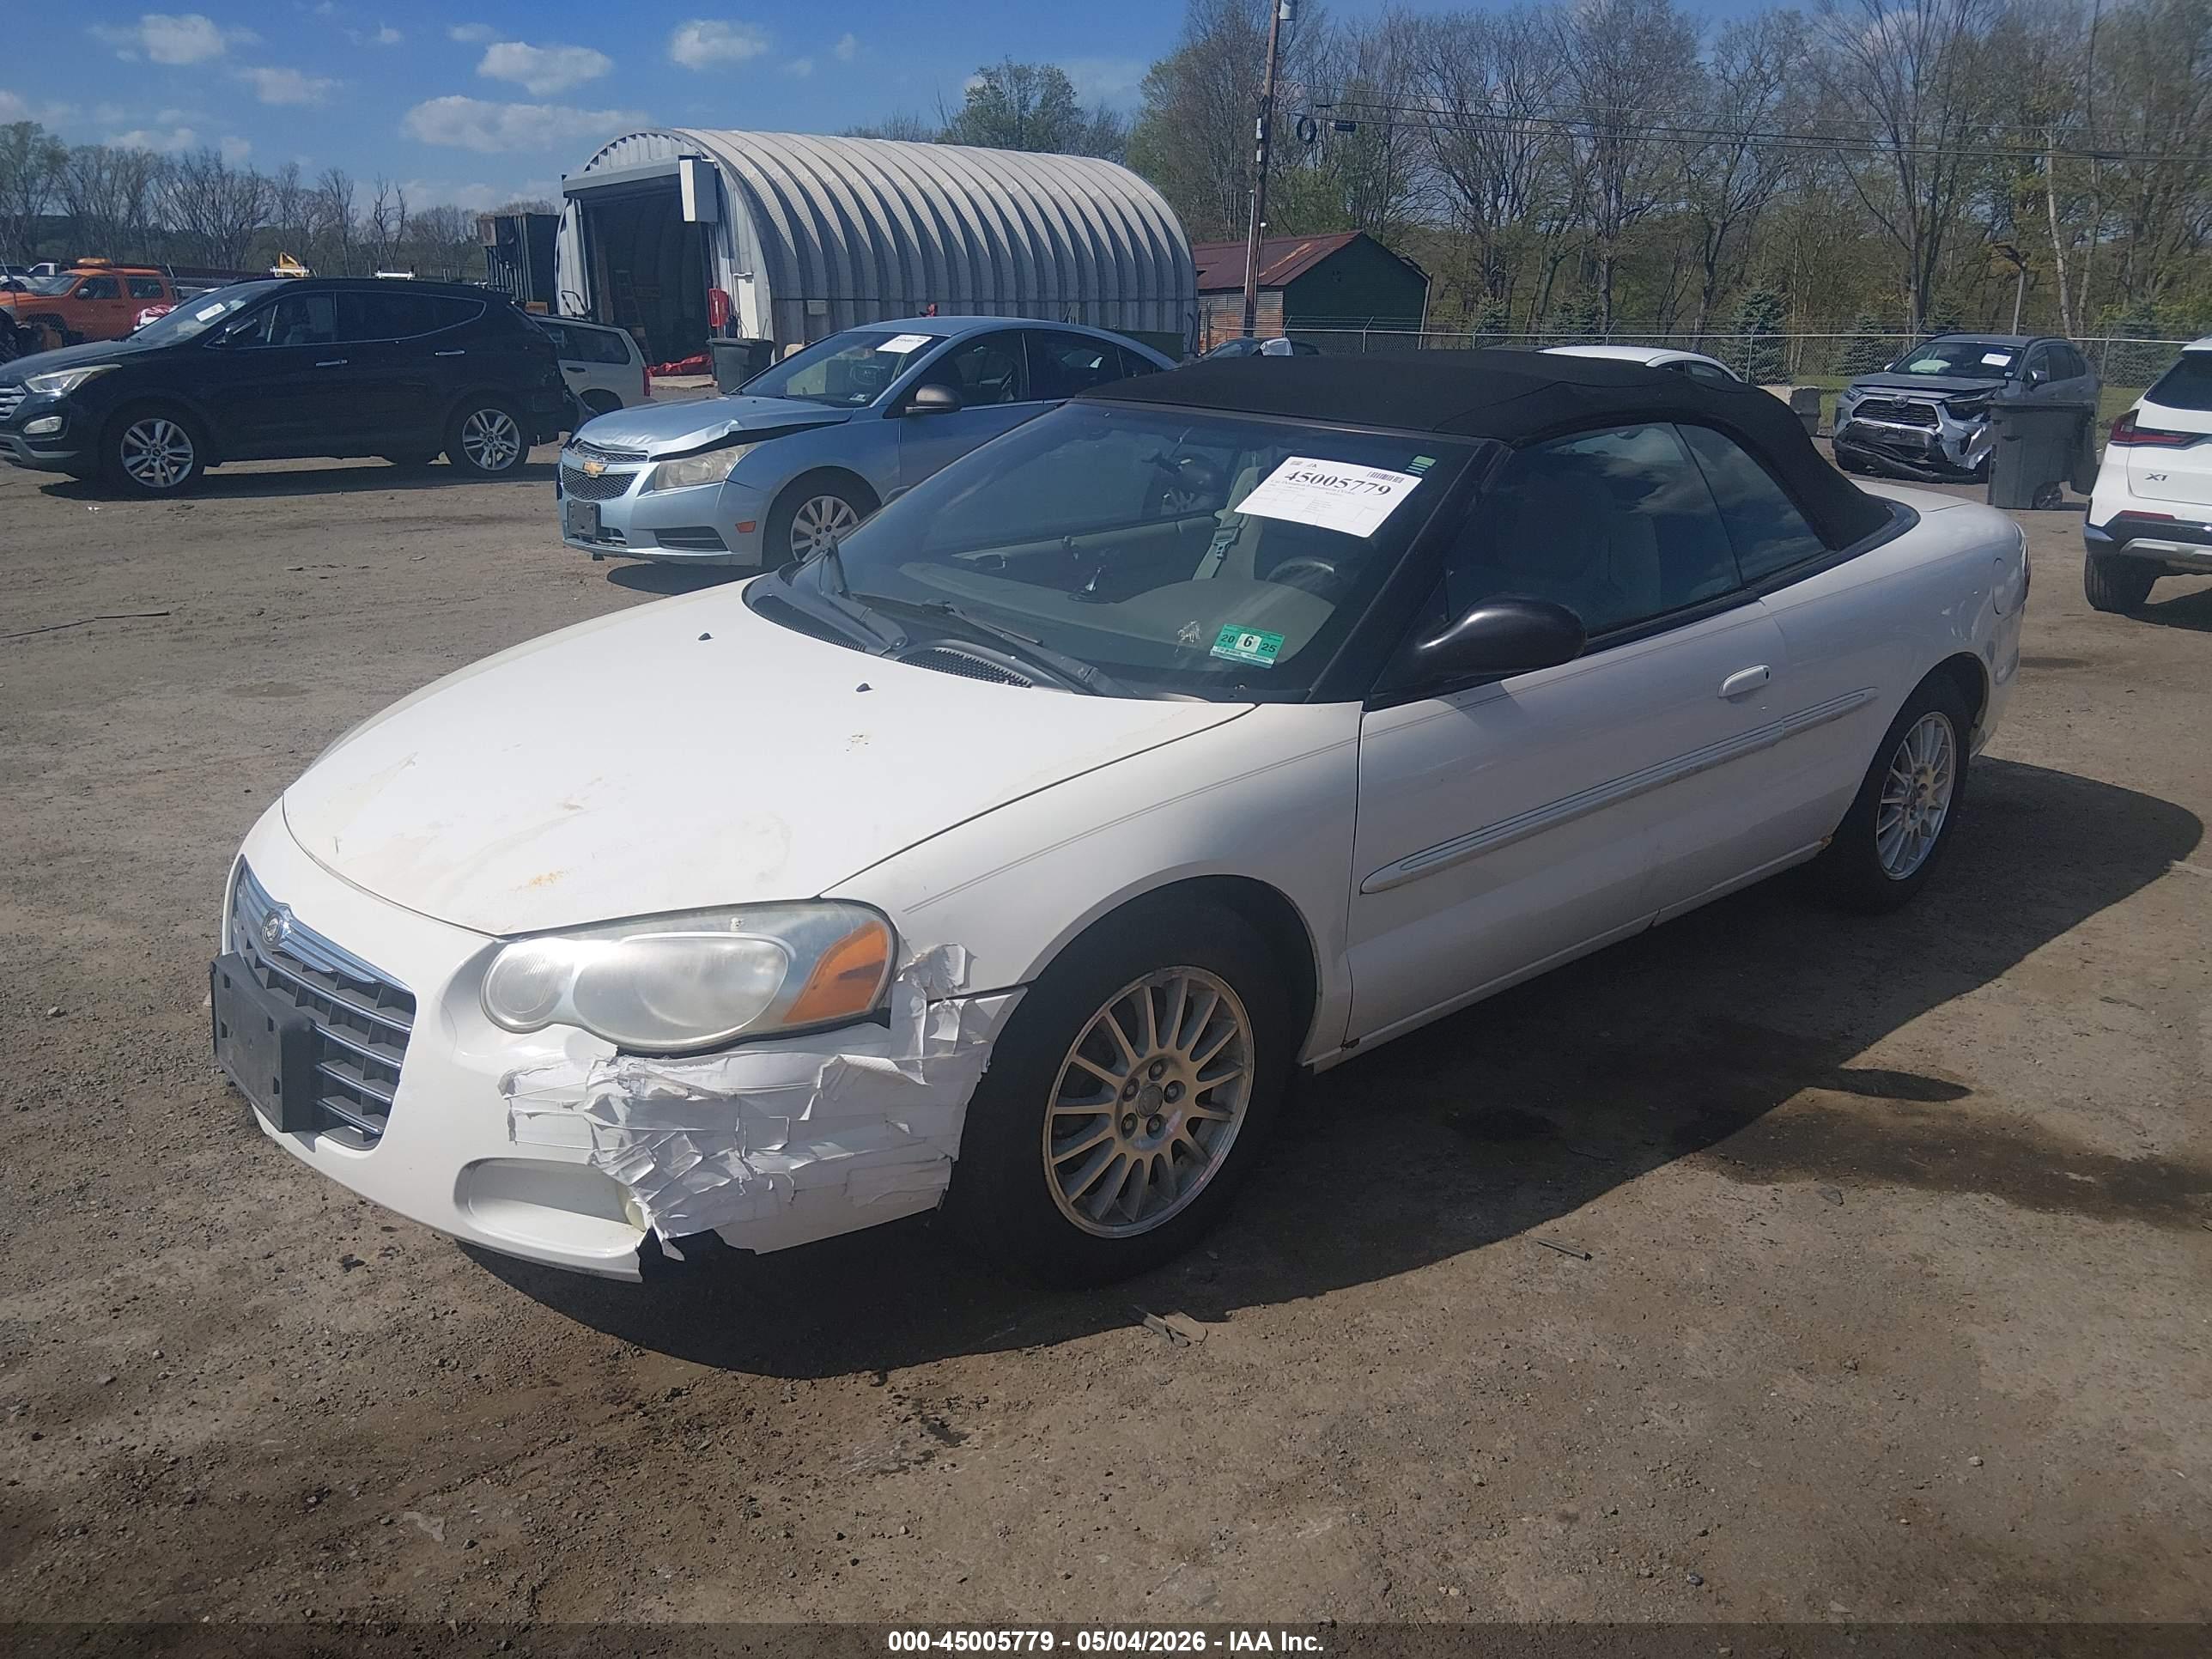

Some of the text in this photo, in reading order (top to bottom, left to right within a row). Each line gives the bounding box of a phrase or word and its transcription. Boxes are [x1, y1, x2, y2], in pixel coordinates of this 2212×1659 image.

[1284, 471, 1392, 495] 45005779
[2145, 473, 2169, 482] X1
[1220, 634, 1278, 653] 20 6 25
